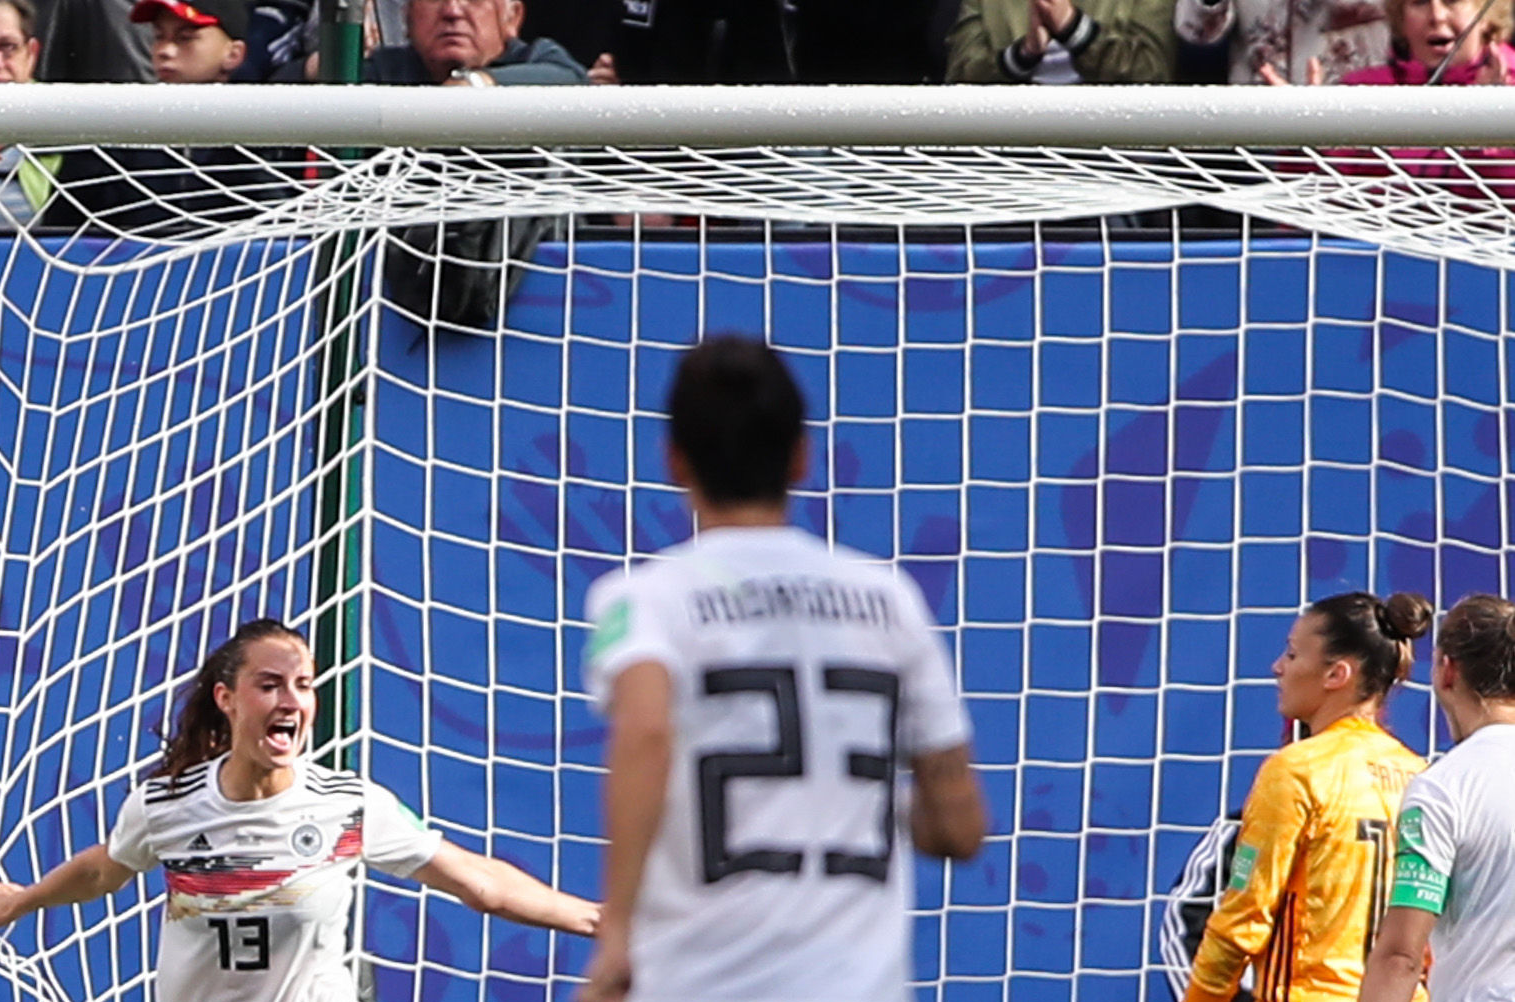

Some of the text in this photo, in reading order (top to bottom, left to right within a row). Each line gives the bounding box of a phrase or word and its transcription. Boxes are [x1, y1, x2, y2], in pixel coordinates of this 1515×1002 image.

[698, 666, 899, 884] 23
[1366, 759, 1417, 795] PAÑ
[208, 917, 270, 970] 13
